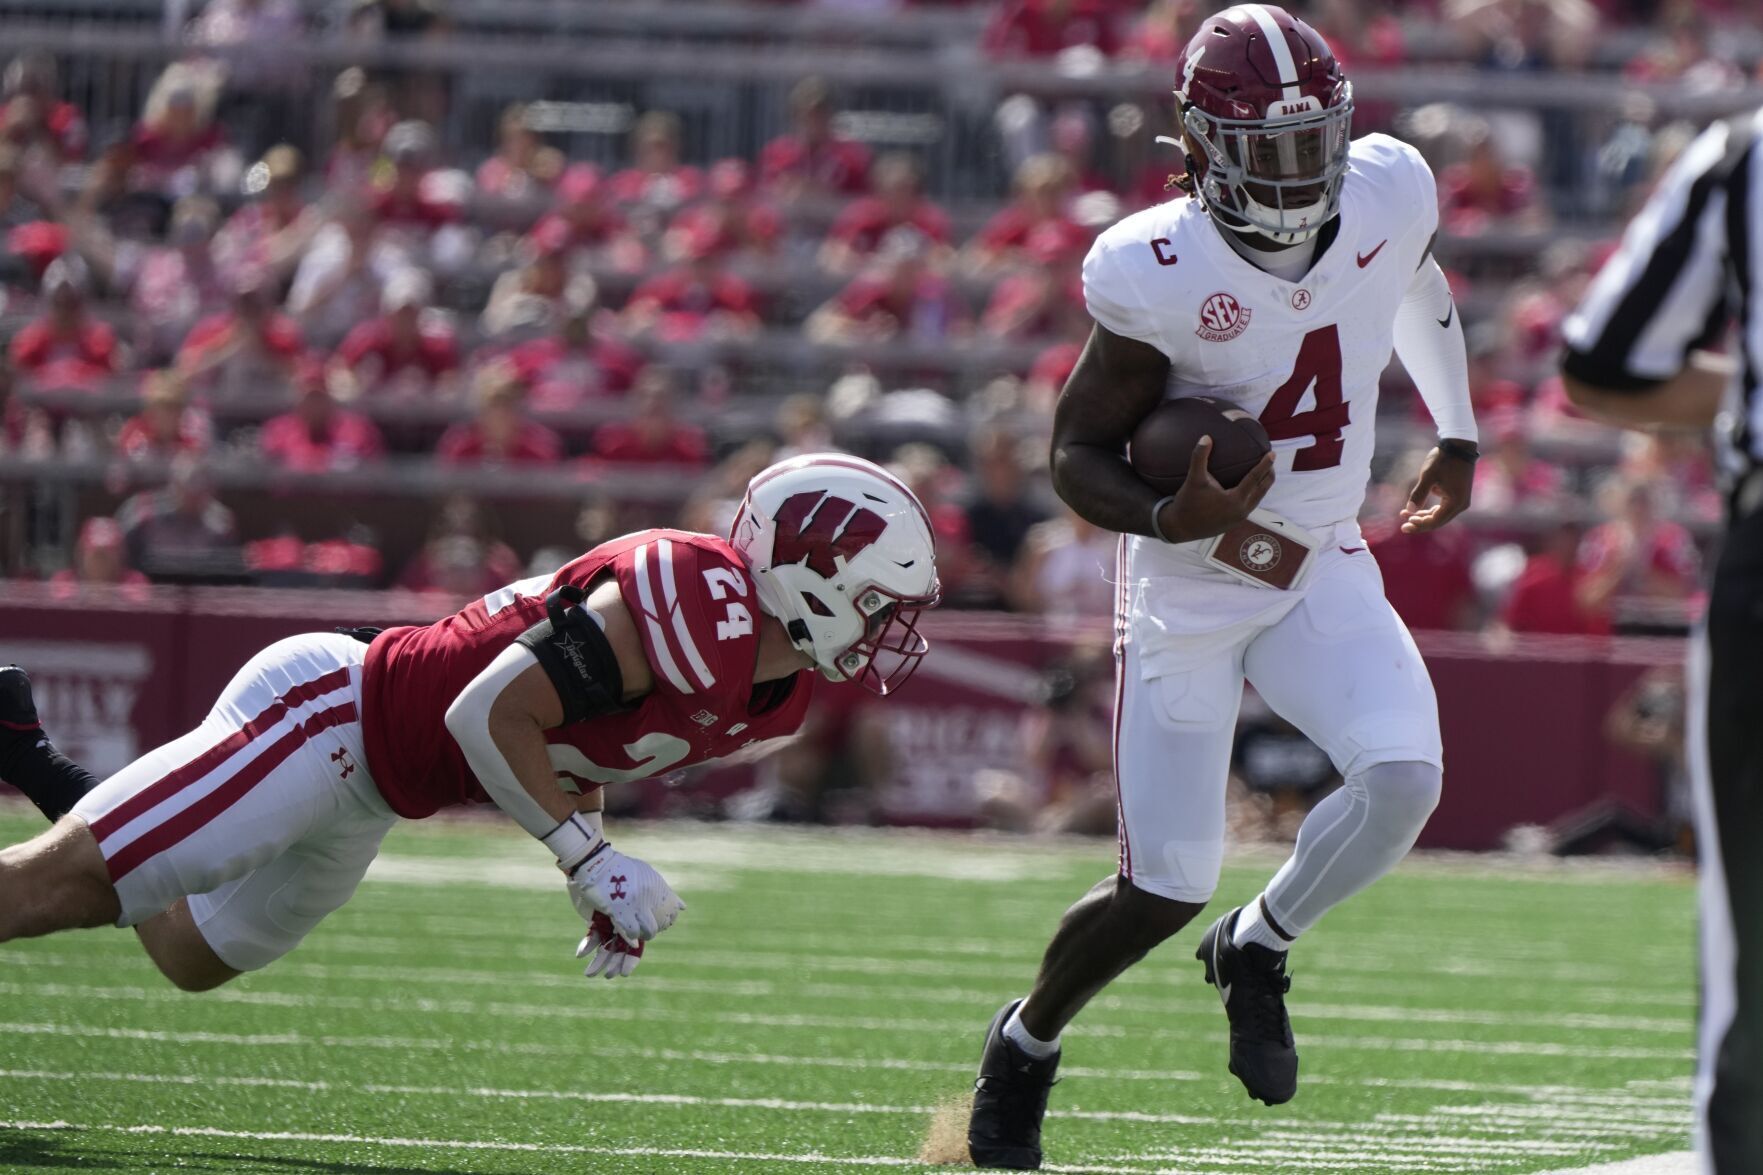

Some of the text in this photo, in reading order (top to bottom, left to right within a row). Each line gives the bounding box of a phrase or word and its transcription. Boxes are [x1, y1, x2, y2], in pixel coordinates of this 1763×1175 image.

[1182, 44, 1205, 97] 4
[1281, 101, 1312, 116] BAMA
[1150, 237, 1178, 266] C
[1200, 293, 1239, 330] SEC
[1205, 320, 1248, 343] GRADUATE
[1258, 323, 1351, 472] 4
[770, 489, 888, 580] W
[702, 566, 753, 641] 24
[565, 643, 589, 679] Douglas
